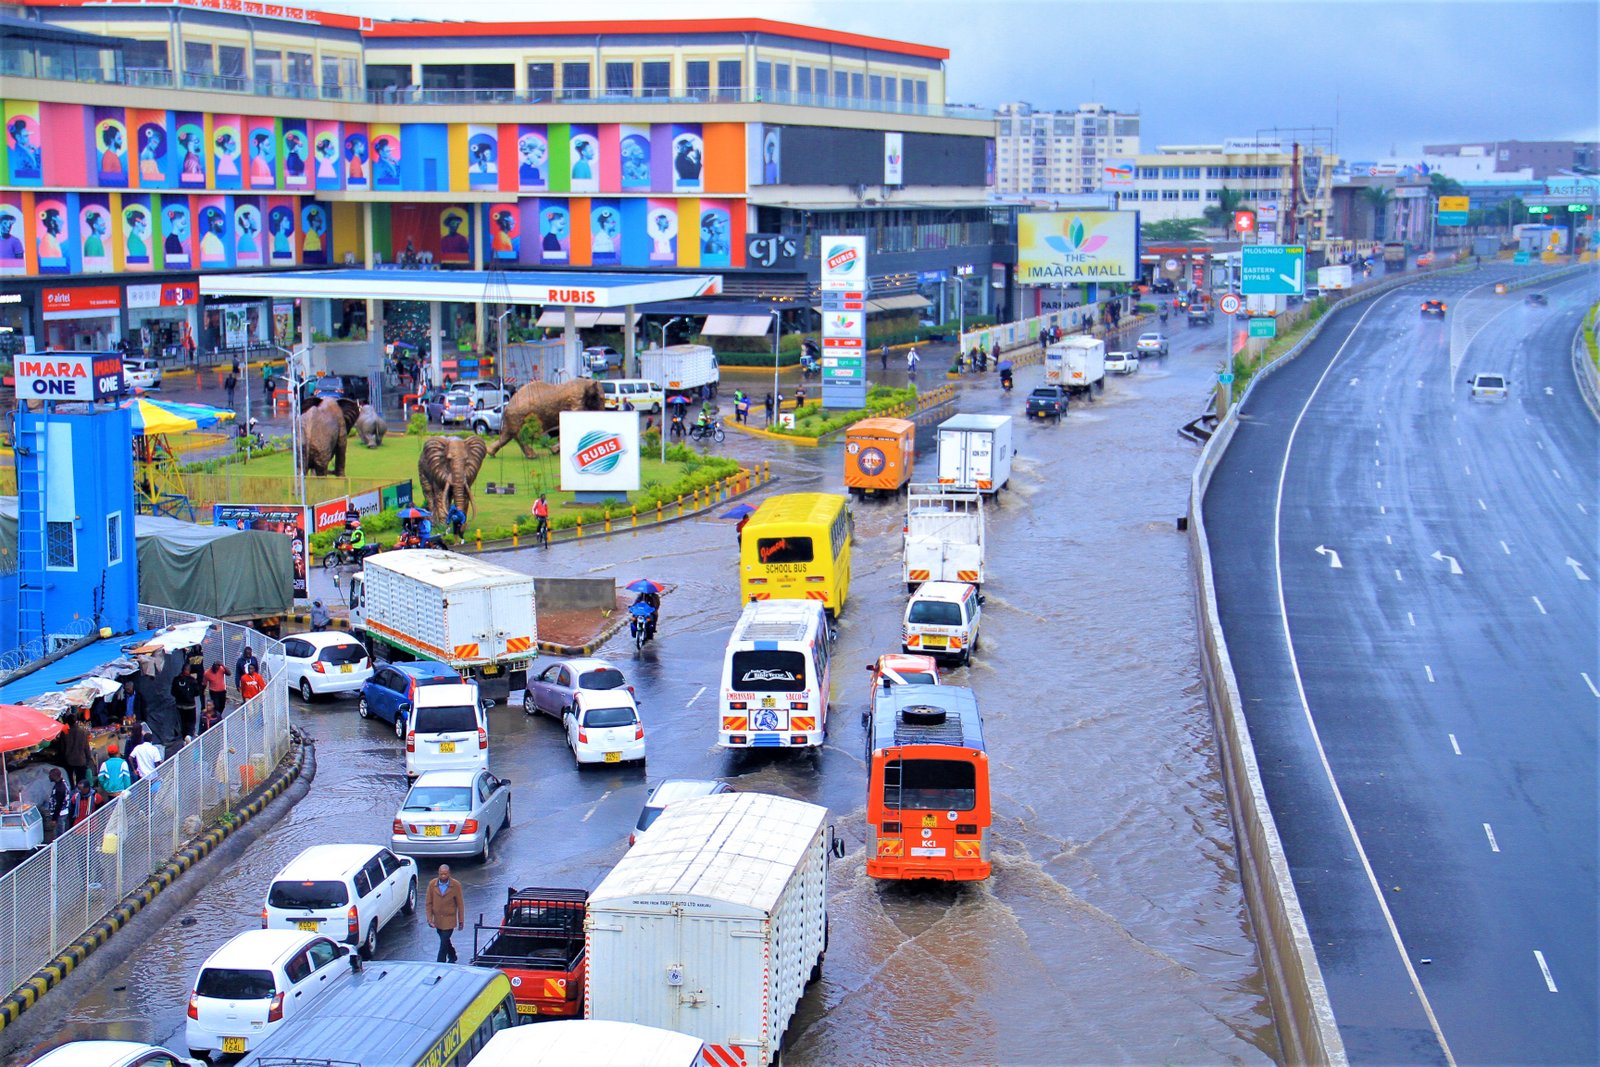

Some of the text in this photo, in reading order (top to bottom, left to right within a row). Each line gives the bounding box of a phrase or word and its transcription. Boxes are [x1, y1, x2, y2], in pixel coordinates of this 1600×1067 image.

[1065, 253, 1087, 262] THE
[1028, 265, 1126, 277] IMAARA MALL
[1223, 299, 1237, 310] 40
[20, 361, 87, 377] IMARA
[94, 359, 121, 376] IMARA
[32, 379, 76, 394] ONE
[99, 376, 118, 393] ONE
[319, 510, 347, 527] Bata
[766, 564, 807, 573] SCHOOL BUS
[785, 692, 802, 701] SACCO
[224, 1037, 238, 1045] KCV
